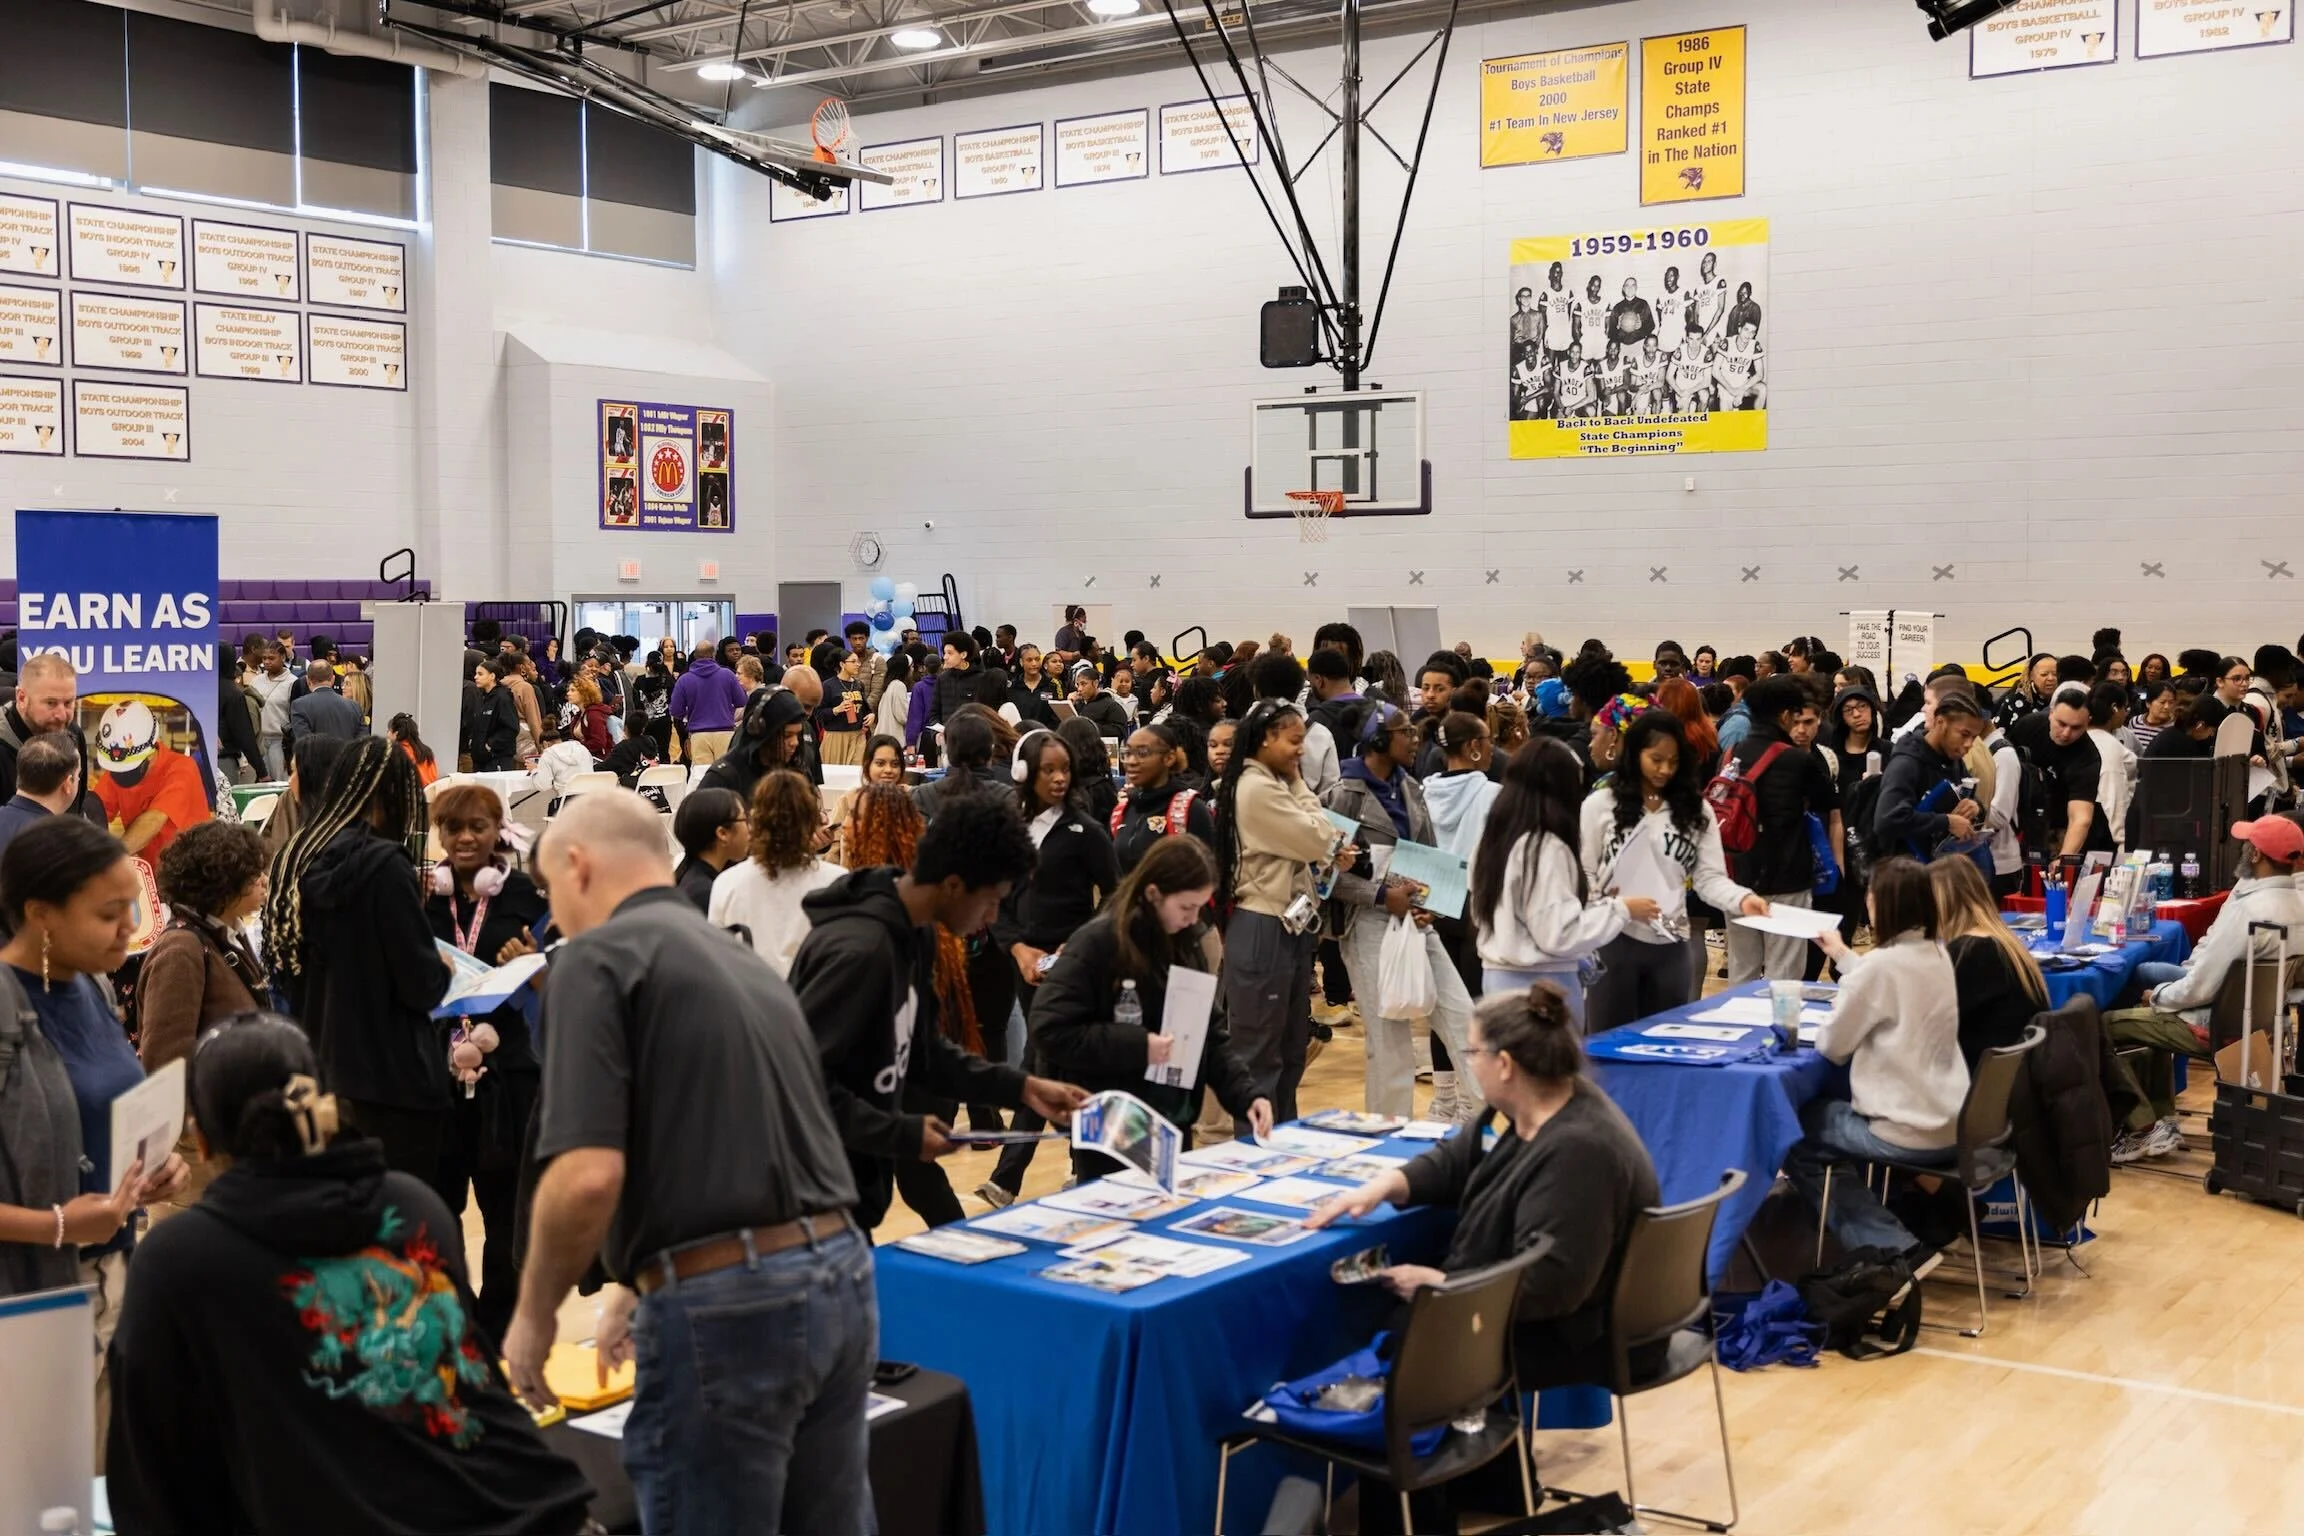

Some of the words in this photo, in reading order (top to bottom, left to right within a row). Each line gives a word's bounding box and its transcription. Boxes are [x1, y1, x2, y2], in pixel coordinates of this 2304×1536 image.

[1987, 19, 2018, 32] BOYS
[2021, 9, 2103, 28] BASKETBALL
[2183, 10, 2229, 23] GROUP
[2232, 7, 2246, 18] IV
[1677, 36, 1710, 53] 1986
[2015, 31, 2058, 45] GROUP
[2060, 29, 2072, 39] IV
[1485, 59, 1547, 74] Tournament
[1550, 57, 1561, 67] of
[1564, 48, 1623, 66] Champions
[1664, 60, 1704, 75] Group
[1708, 55, 1722, 70] IV
[1511, 79, 1536, 90] Boys
[1540, 70, 1596, 87] Basketball
[1675, 80, 1710, 95] State
[1539, 92, 1567, 106] 2000
[1489, 119, 1501, 131] #1
[1506, 117, 1535, 130] Team
[1539, 114, 1549, 126] In
[1553, 112, 1577, 125] New
[1581, 107, 1619, 122] Jersey
[1665, 102, 1720, 119] Champs
[1657, 123, 1706, 141] Ranked
[1711, 121, 1727, 135] #1
[1648, 149, 1660, 164] in
[1664, 148, 1689, 162] The
[1693, 143, 1737, 159] Nation
[1572, 228, 1709, 257] 1959-1960
[1557, 418, 1586, 429] Back
[1589, 418, 1601, 427] to
[1604, 416, 1634, 427] Back
[1637, 413, 1708, 425] Undefeated
[1580, 432, 1610, 441] State
[1613, 429, 1683, 442] Champions
[19, 592, 141, 630] EARN
[151, 592, 211, 629] AS
[1856, 623, 1870, 631] PAVE
[1871, 623, 1881, 631] THE
[1899, 623, 1912, 632] FIND
[1913, 624, 1928, 633] YOUR
[1861, 632, 1876, 640] ROAD
[1857, 641, 1865, 650] TO
[1866, 641, 1880, 650] YOUR
[104, 644, 213, 673] LEARN
[1856, 651, 1880, 659] SUCCESS
